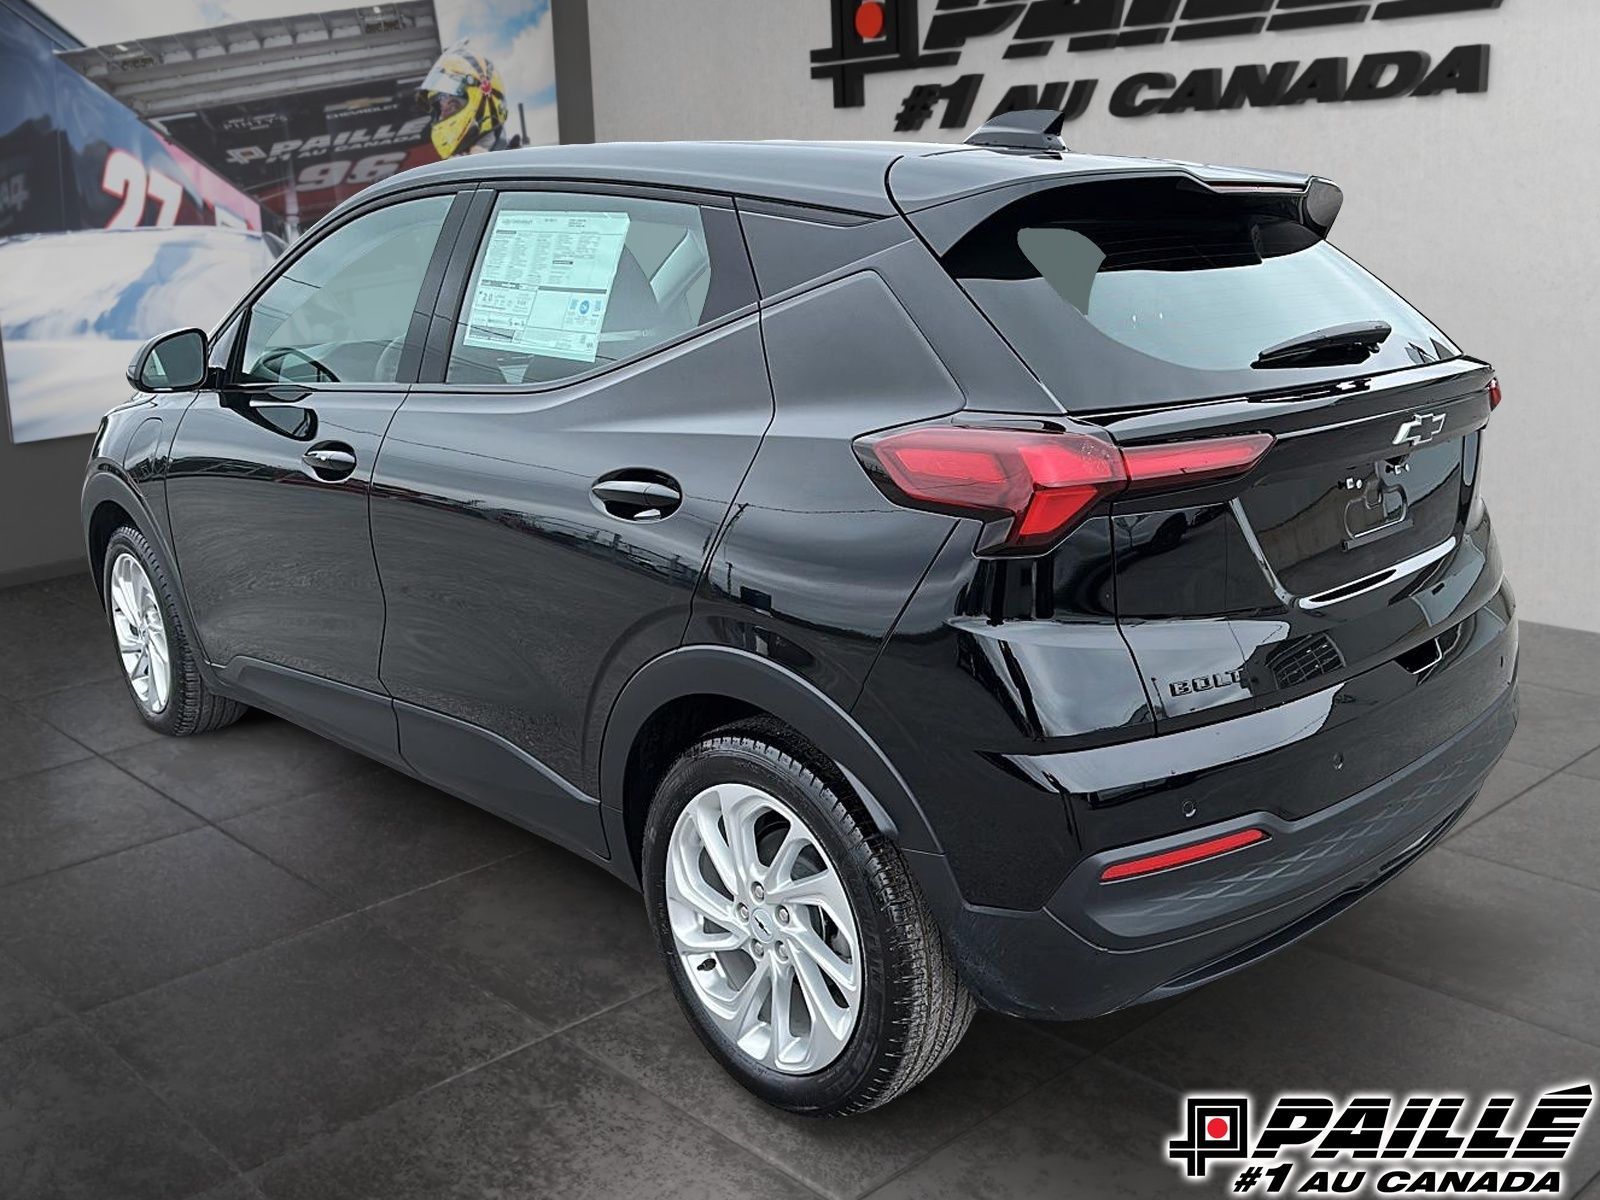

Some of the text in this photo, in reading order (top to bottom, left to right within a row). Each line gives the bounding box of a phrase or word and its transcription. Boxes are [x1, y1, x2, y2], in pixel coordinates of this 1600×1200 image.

[893, 73, 985, 133] #1
[1108, 44, 1491, 118] CANADA
[325, 104, 399, 120] CHEVROLET
[333, 133, 422, 153] CANADA
[102, 147, 184, 230] 27
[295, 152, 407, 192] 96
[1169, 668, 1244, 697] BOLT
